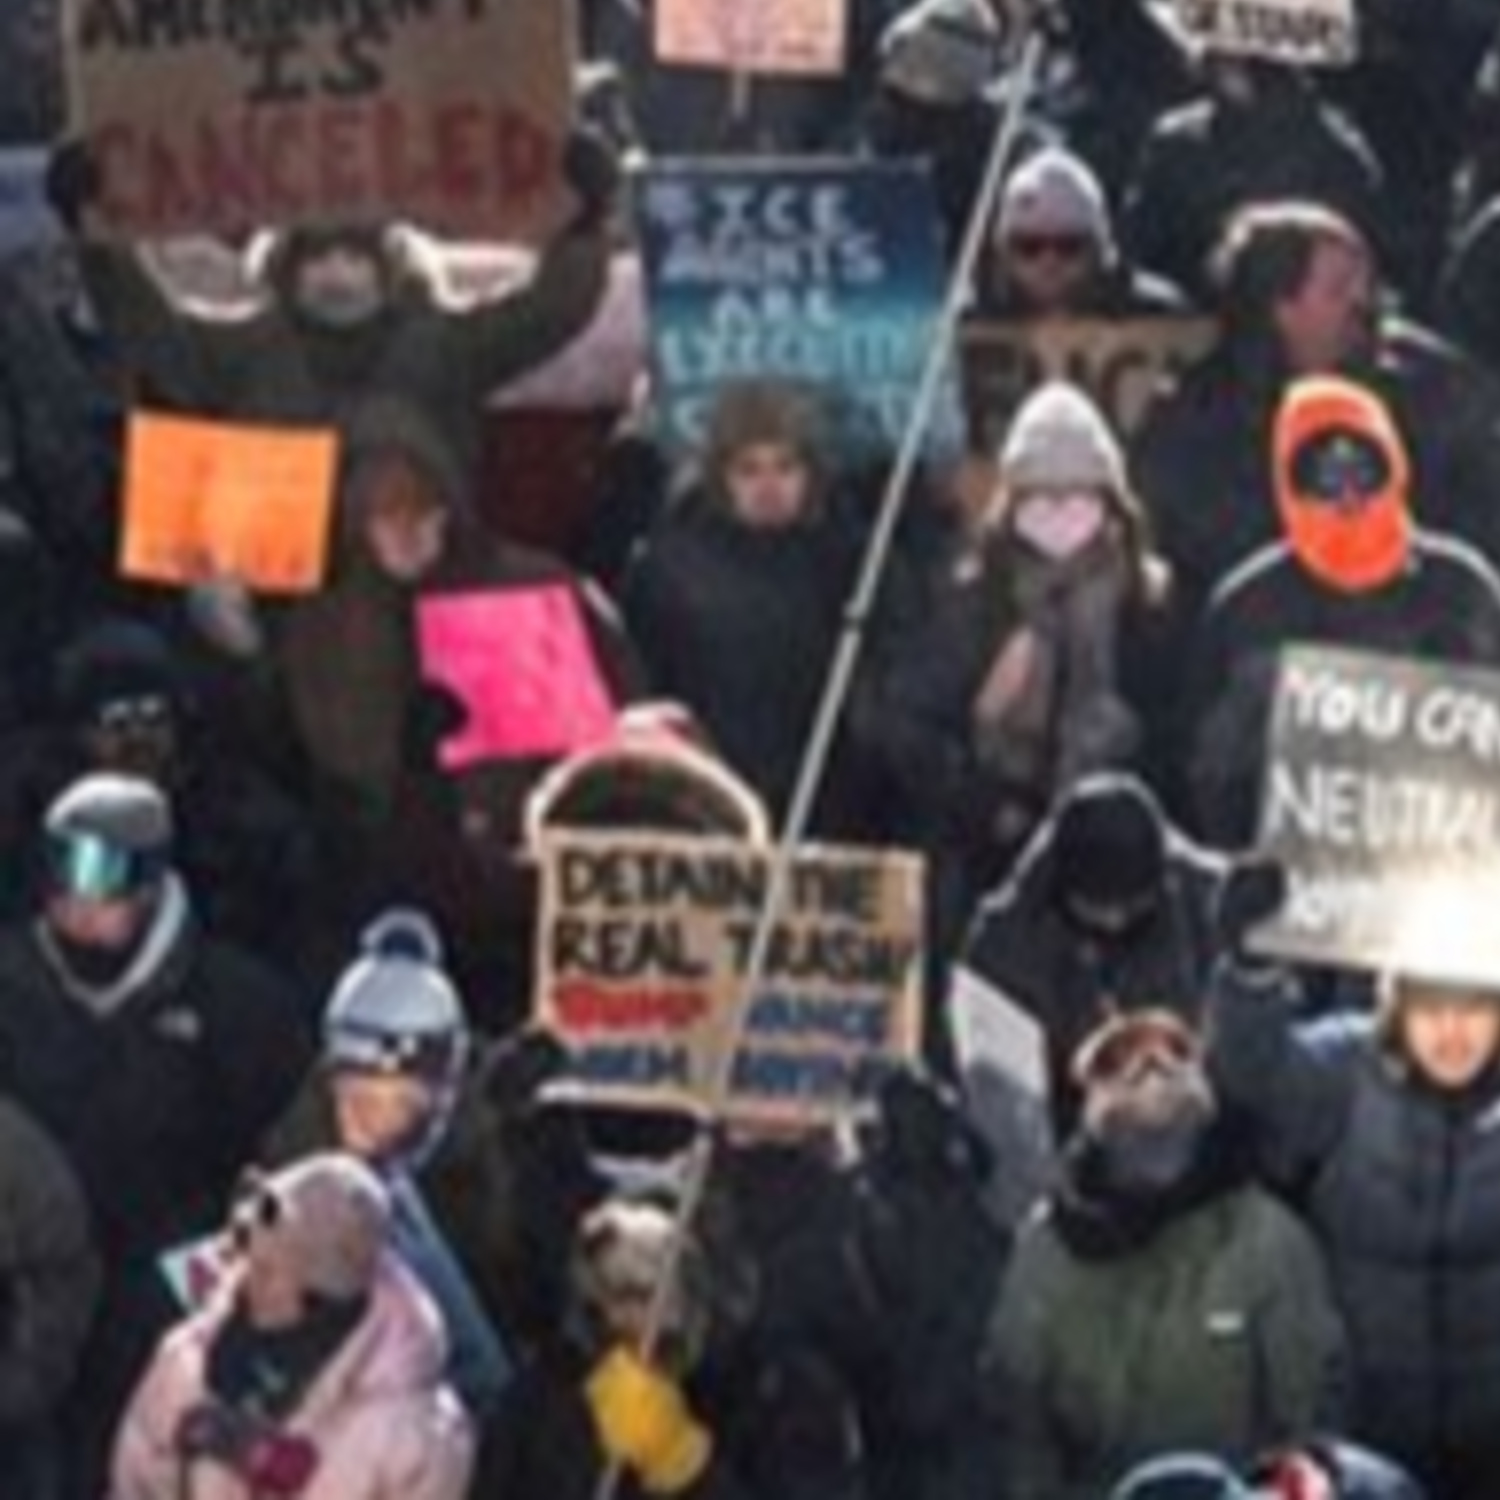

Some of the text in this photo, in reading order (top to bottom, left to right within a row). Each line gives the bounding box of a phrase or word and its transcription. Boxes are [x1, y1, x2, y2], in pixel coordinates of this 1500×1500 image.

[241, 30, 390, 104] IS
[92, 98, 551, 222] CANCELED
[710, 184, 846, 235] ICE
[1287, 668, 1405, 740] YOU
[560, 848, 769, 913] DETAIN
[554, 917, 711, 977] REAL
